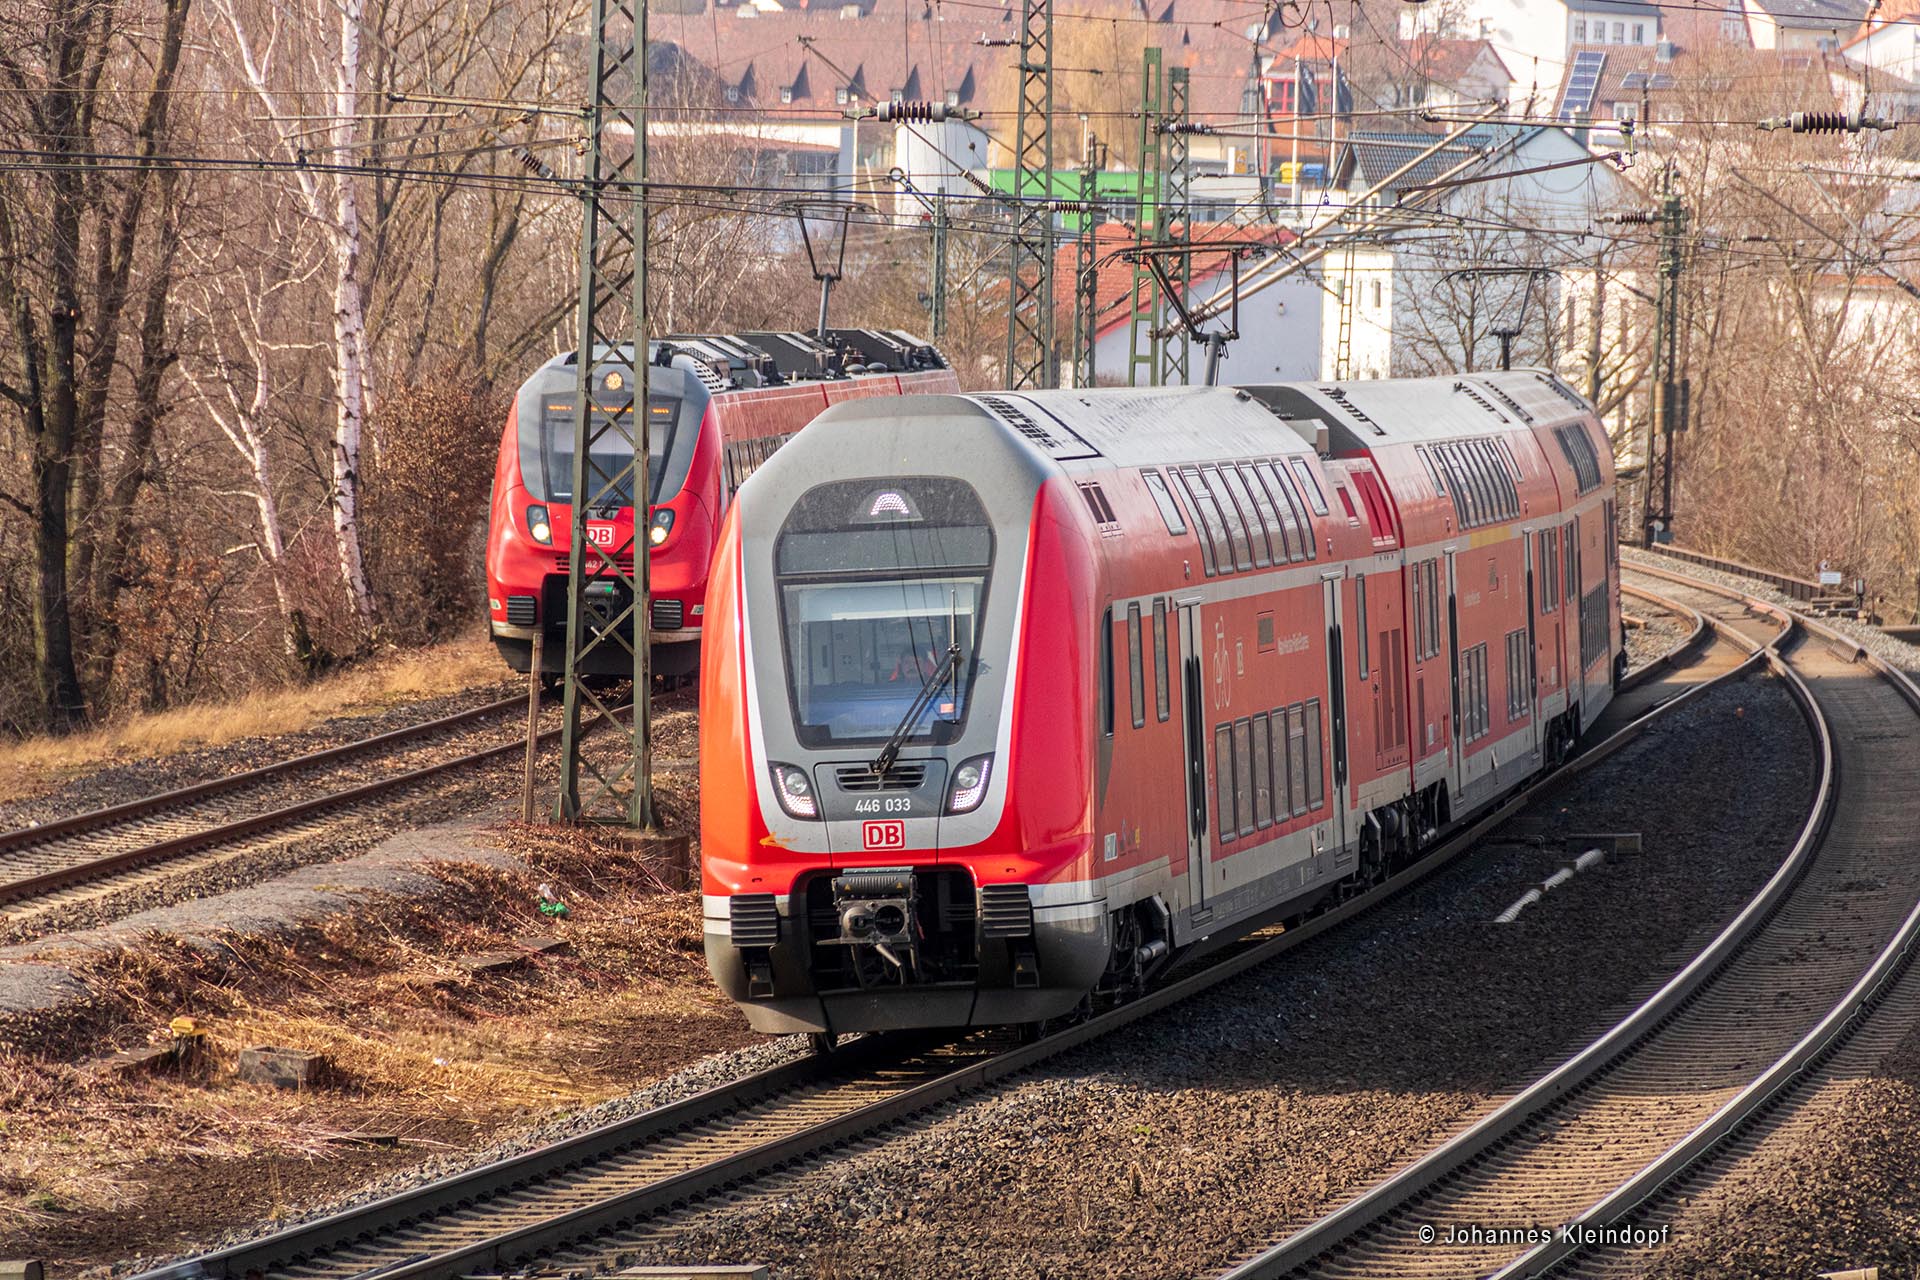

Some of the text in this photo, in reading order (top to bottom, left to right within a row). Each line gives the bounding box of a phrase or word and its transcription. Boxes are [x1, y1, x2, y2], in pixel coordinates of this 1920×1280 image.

[855, 798, 911, 813] 446 033
[868, 824, 901, 846] DB
